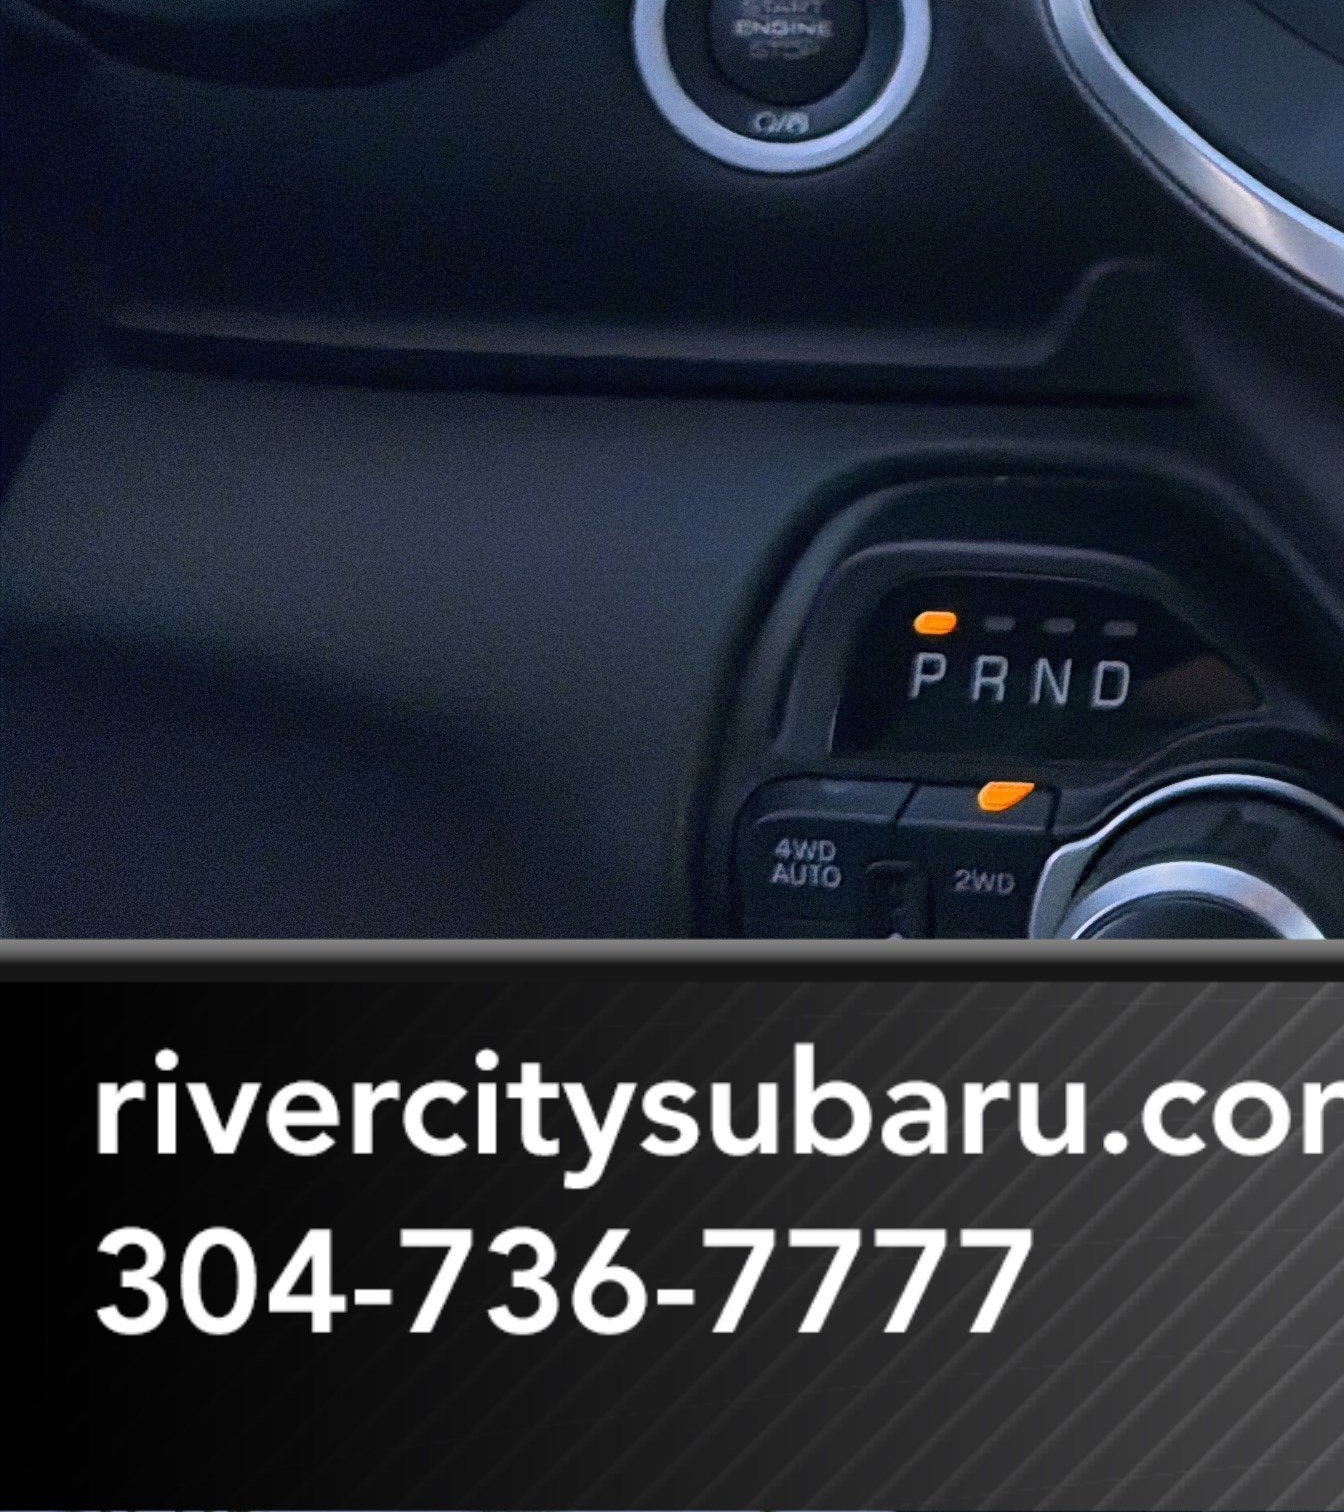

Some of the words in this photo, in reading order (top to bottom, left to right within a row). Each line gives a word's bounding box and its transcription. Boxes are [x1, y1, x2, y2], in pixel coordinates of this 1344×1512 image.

[908, 652, 947, 699] P
[970, 655, 1010, 702] R
[1029, 658, 1074, 706] N
[1090, 660, 1131, 708] D
[774, 837, 837, 862] 4WD
[770, 862, 842, 889] AUTO
[953, 868, 1016, 896] 2WD
